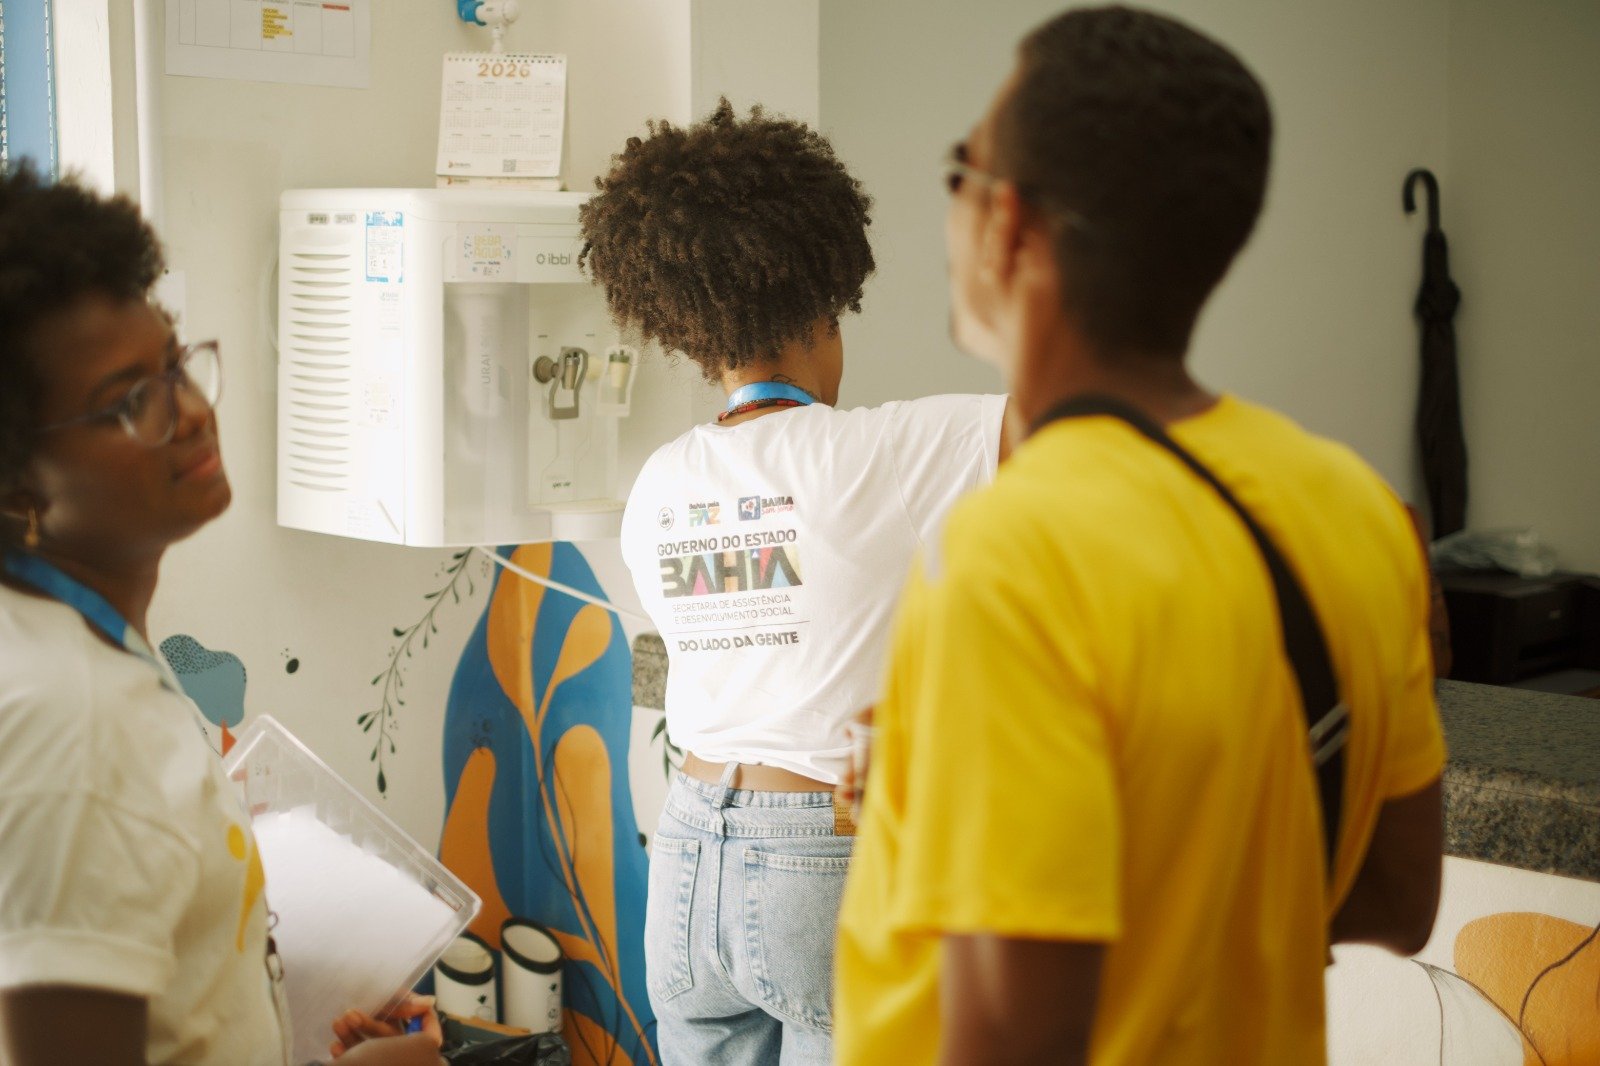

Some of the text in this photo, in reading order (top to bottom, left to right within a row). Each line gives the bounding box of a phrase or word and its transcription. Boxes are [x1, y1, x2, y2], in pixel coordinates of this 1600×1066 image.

[477, 62, 530, 78] 2026
[547, 252, 570, 265] ibbl
[761, 496, 794, 508] BAHIA
[688, 506, 720, 527] PAZ
[657, 529, 797, 557] GOVERNO DO ESTADO
[659, 545, 803, 599] BAHIA
[672, 594, 791, 613] SECRETARIA DE ASSISTÊNCIA
[674, 606, 795, 625] E DESENVOLVIMENTO SOCIAL
[678, 631, 800, 652] DO LADO DA GENTE
